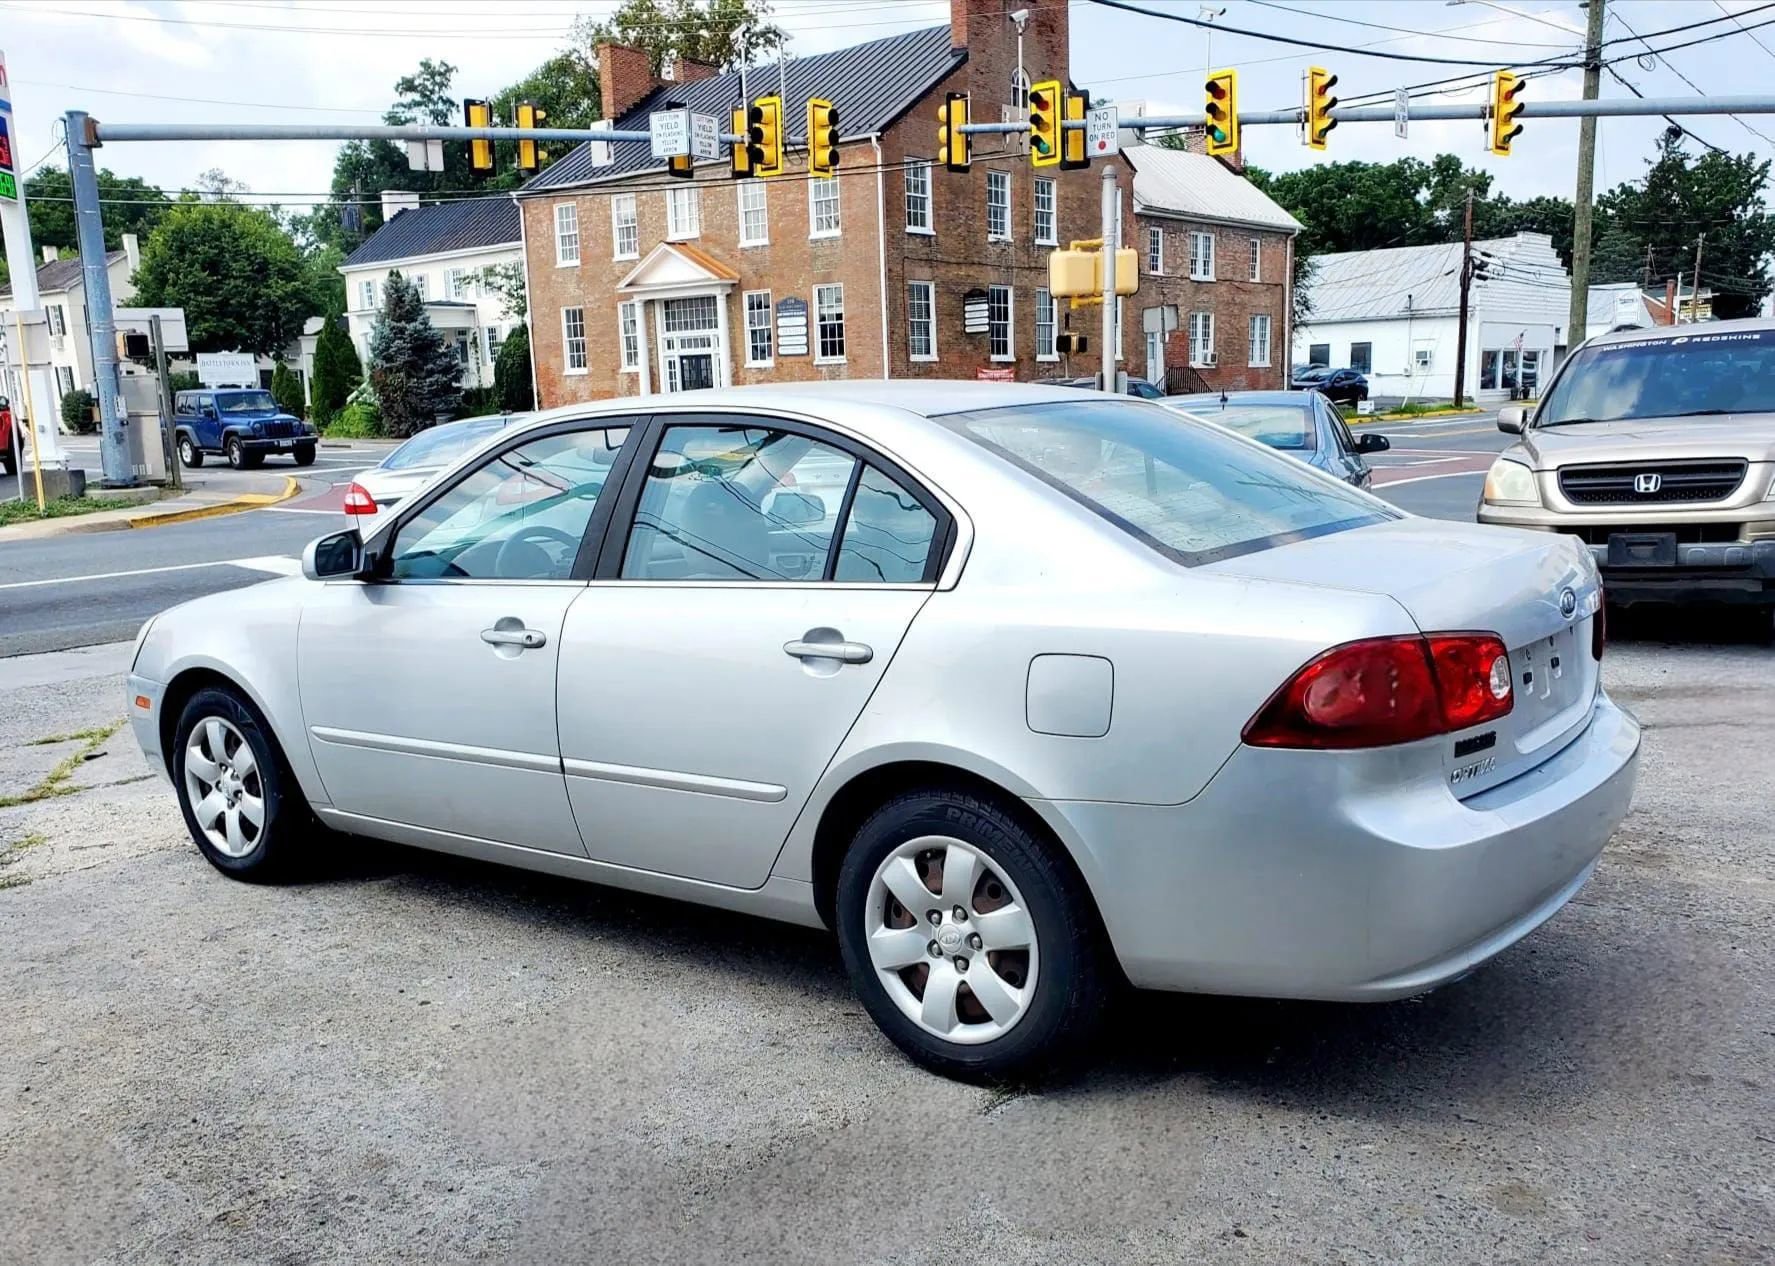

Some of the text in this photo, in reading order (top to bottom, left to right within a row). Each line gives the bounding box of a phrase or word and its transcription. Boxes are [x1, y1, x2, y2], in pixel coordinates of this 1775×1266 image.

[1094, 112, 1108, 121] NO
[659, 121, 678, 130] YIELD
[697, 123, 713, 133] YIELD
[1093, 123, 1111, 132] TURN
[1089, 134, 1098, 142] ON
[1603, 334, 1761, 351] WASHINGTON REDSKINS
[1450, 756, 1496, 784] OPTIMA
